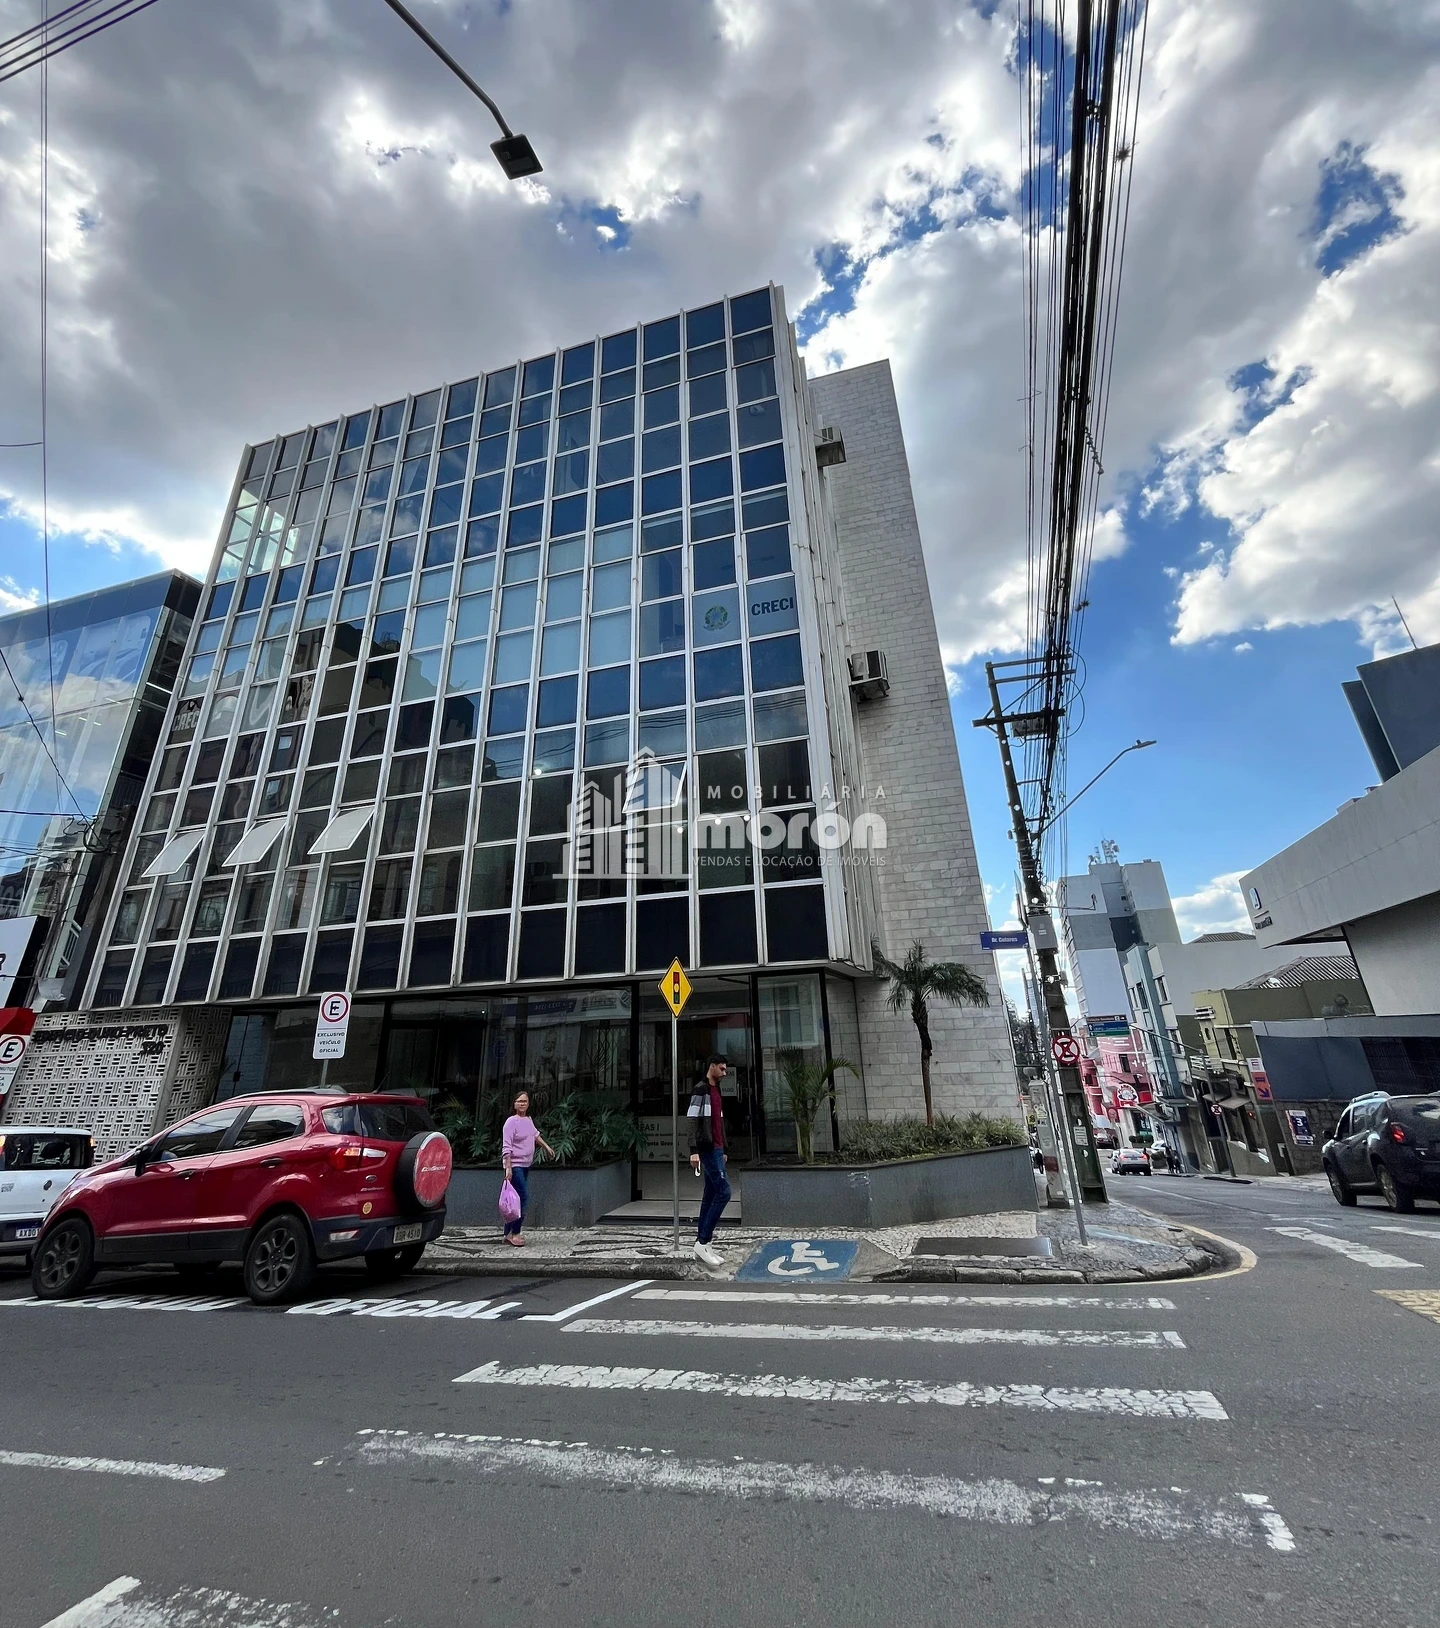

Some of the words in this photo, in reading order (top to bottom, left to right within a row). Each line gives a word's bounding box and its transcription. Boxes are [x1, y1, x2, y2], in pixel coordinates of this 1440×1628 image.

[751, 597, 794, 616] CRECI
[329, 1001, 341, 1015] E
[2, 1042, 19, 1058] E
[285, 1298, 523, 1320] OFICIAL
